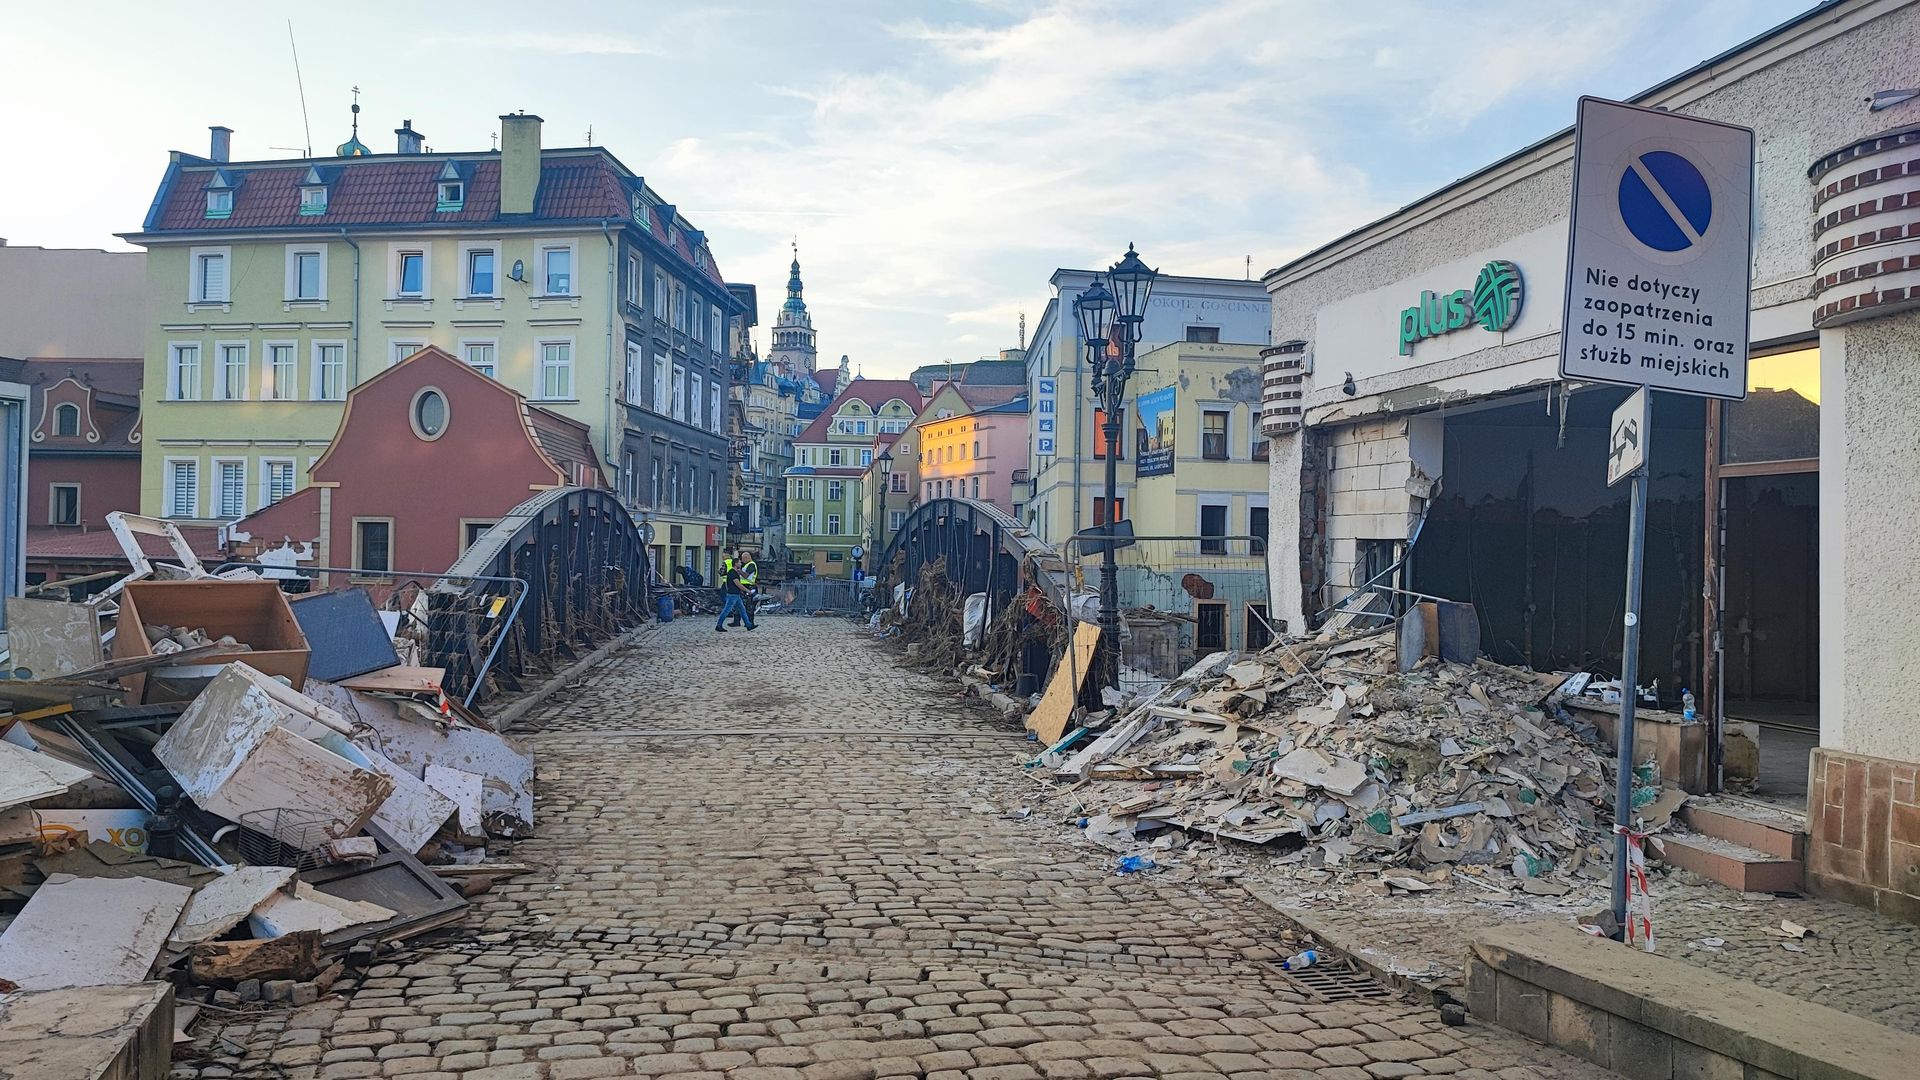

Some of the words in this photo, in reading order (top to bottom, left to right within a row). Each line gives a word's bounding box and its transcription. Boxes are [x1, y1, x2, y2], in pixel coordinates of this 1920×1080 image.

[1586, 267, 1618, 287] Nie
[1628, 275, 1700, 304] dotyczy
[1150, 297, 1194, 311] OKOJE
[1584, 297, 1713, 326] zaopatrzenia
[1399, 289, 1471, 356] plus
[1583, 319, 1607, 336] do
[1617, 322, 1635, 340] 15
[1645, 329, 1684, 347] min.
[1694, 338, 1734, 355] oraz
[1580, 344, 1631, 364] służb
[1641, 354, 1729, 378] miejskich
